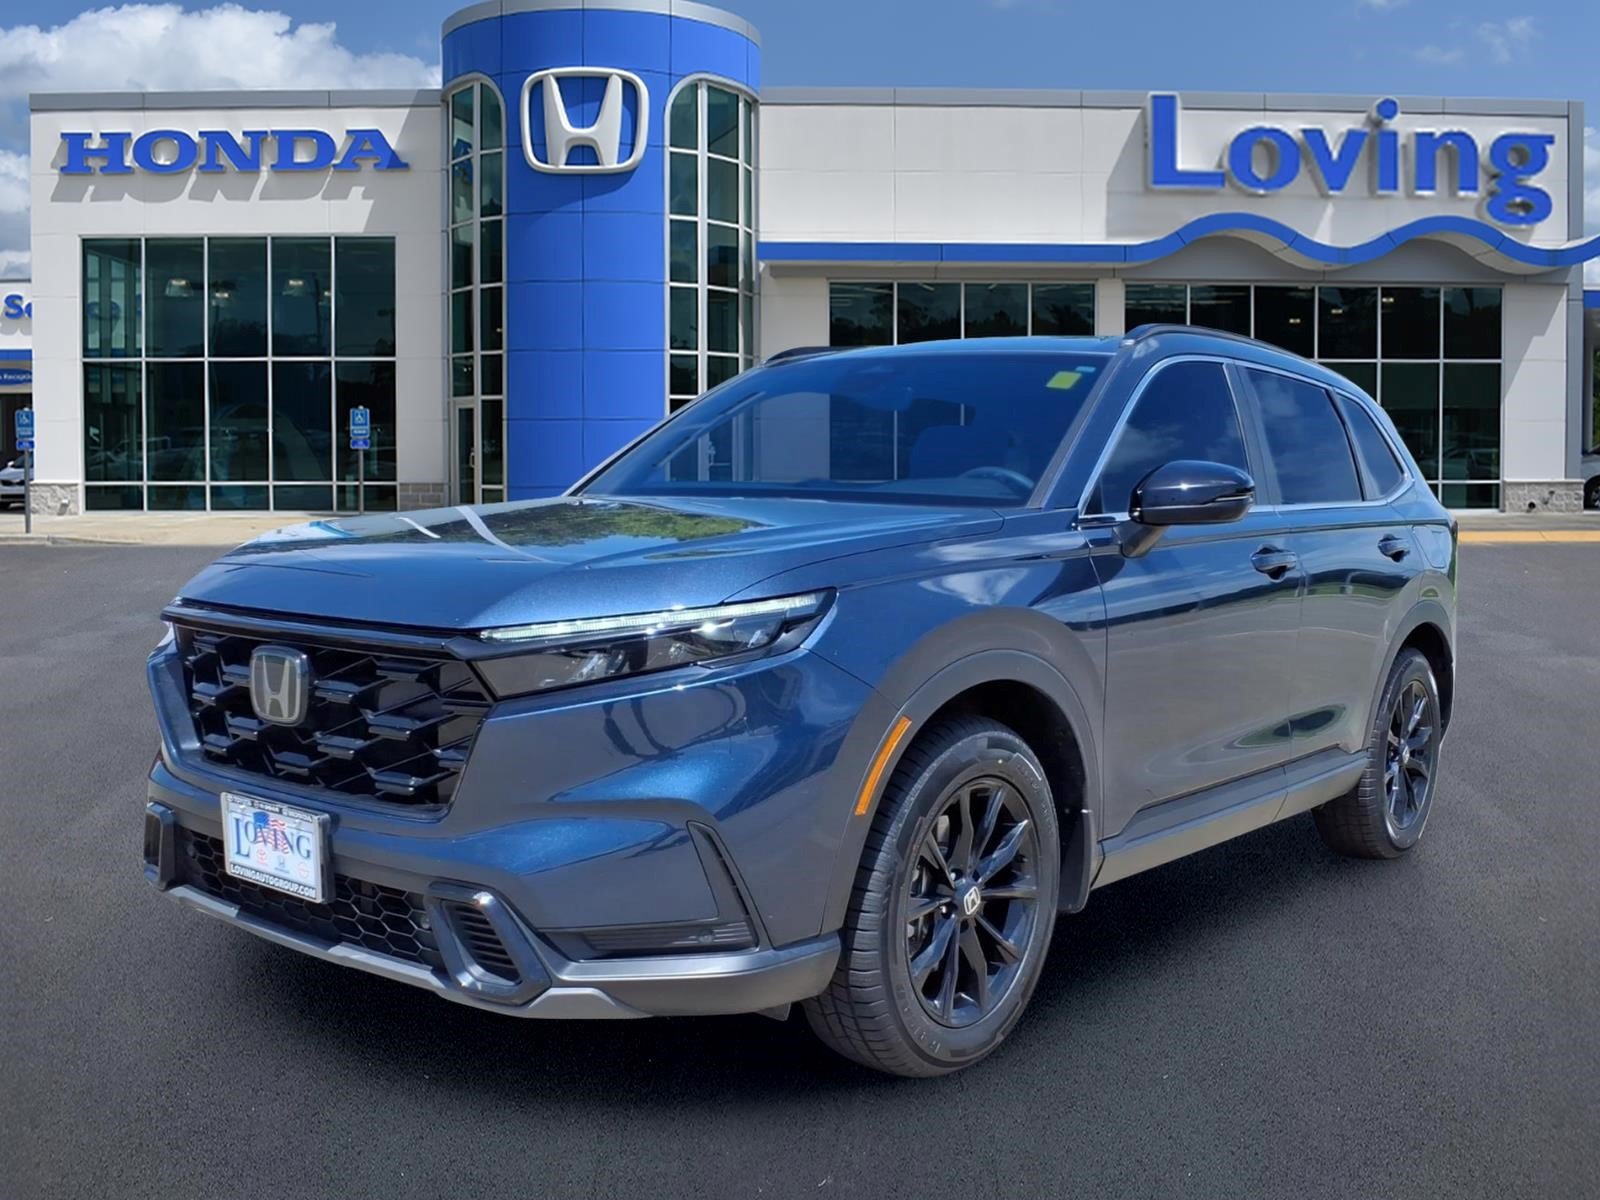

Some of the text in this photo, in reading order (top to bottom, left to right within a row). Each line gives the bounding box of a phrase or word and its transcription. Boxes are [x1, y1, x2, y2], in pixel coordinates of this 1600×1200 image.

[60, 129, 410, 174] HONDA
[1148, 93, 1556, 227] Loving
[232, 817, 311, 860] LOVING
[230, 863, 317, 899] LOVINGAUTOGROUP.COM
